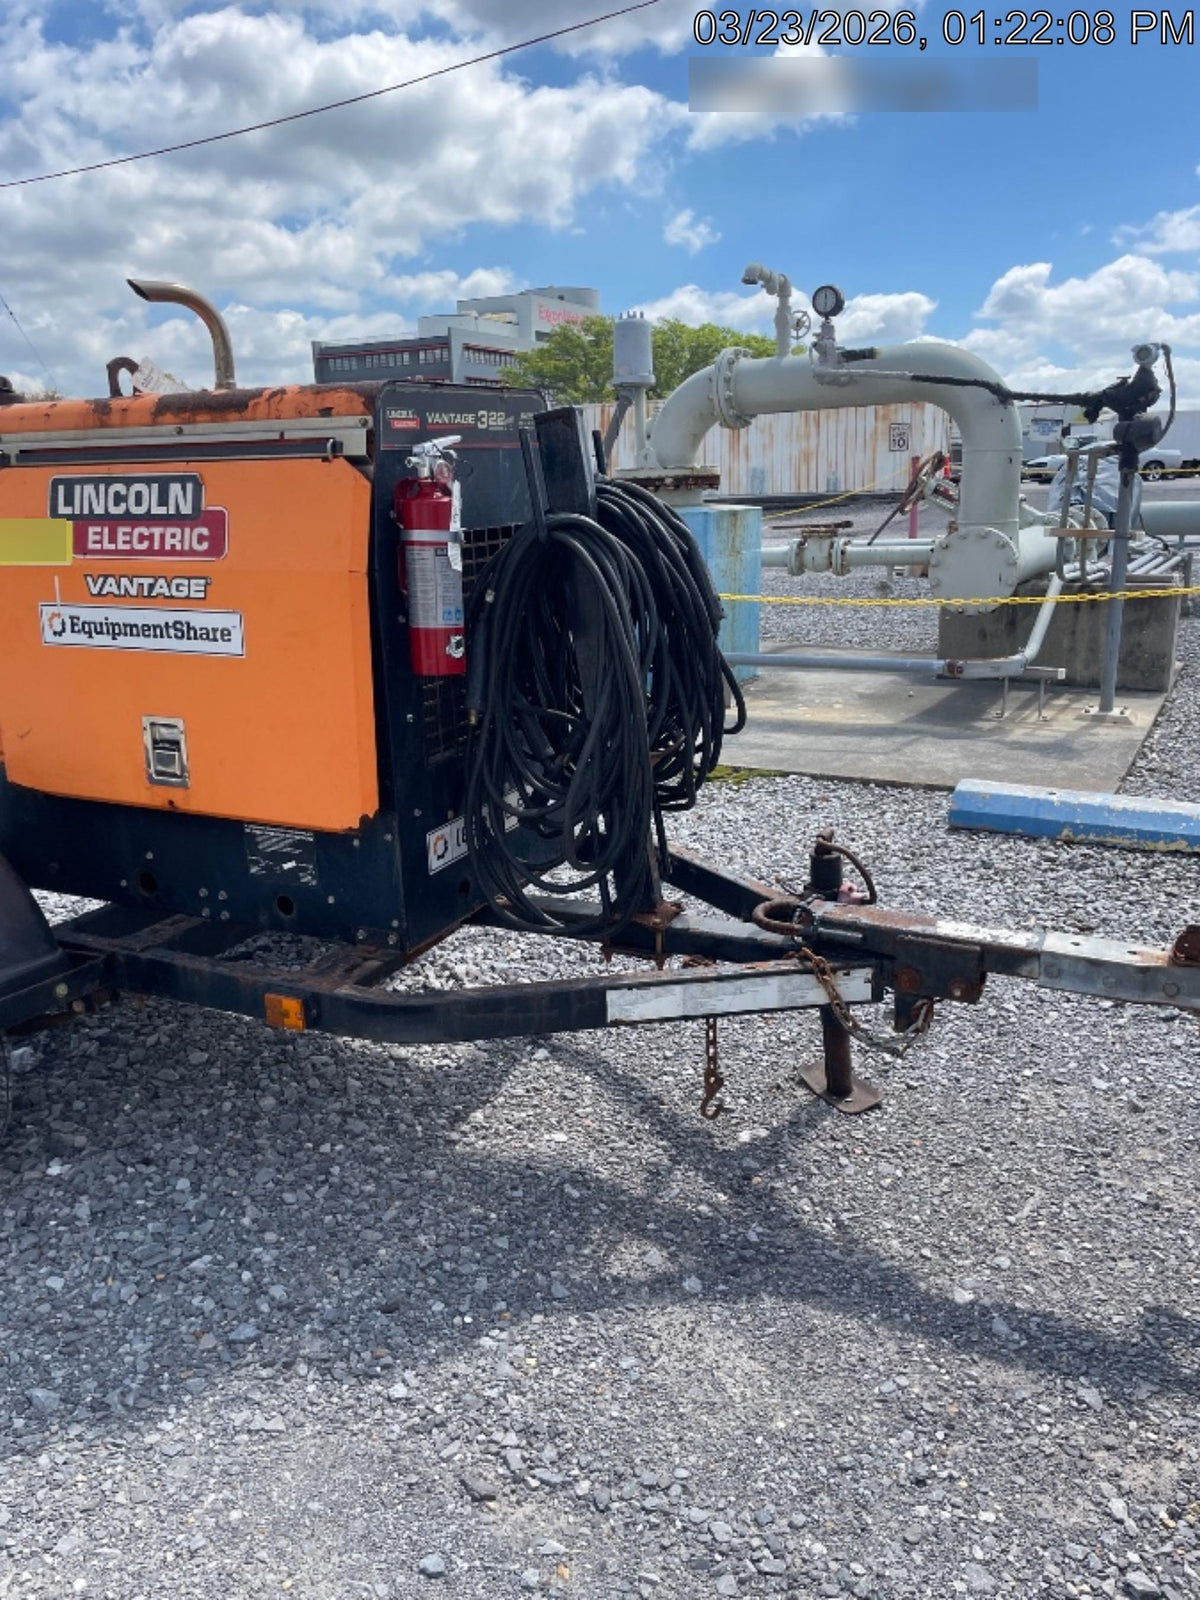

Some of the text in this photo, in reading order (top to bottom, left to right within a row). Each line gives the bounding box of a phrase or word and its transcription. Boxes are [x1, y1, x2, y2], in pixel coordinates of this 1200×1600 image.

[426, 411, 476, 424] VANTAGE
[57, 482, 193, 515] LINCOLN
[87, 526, 209, 551] ELECTRIC
[85, 574, 207, 600] VANTAGE
[69, 615, 232, 643] EquipmentShare
